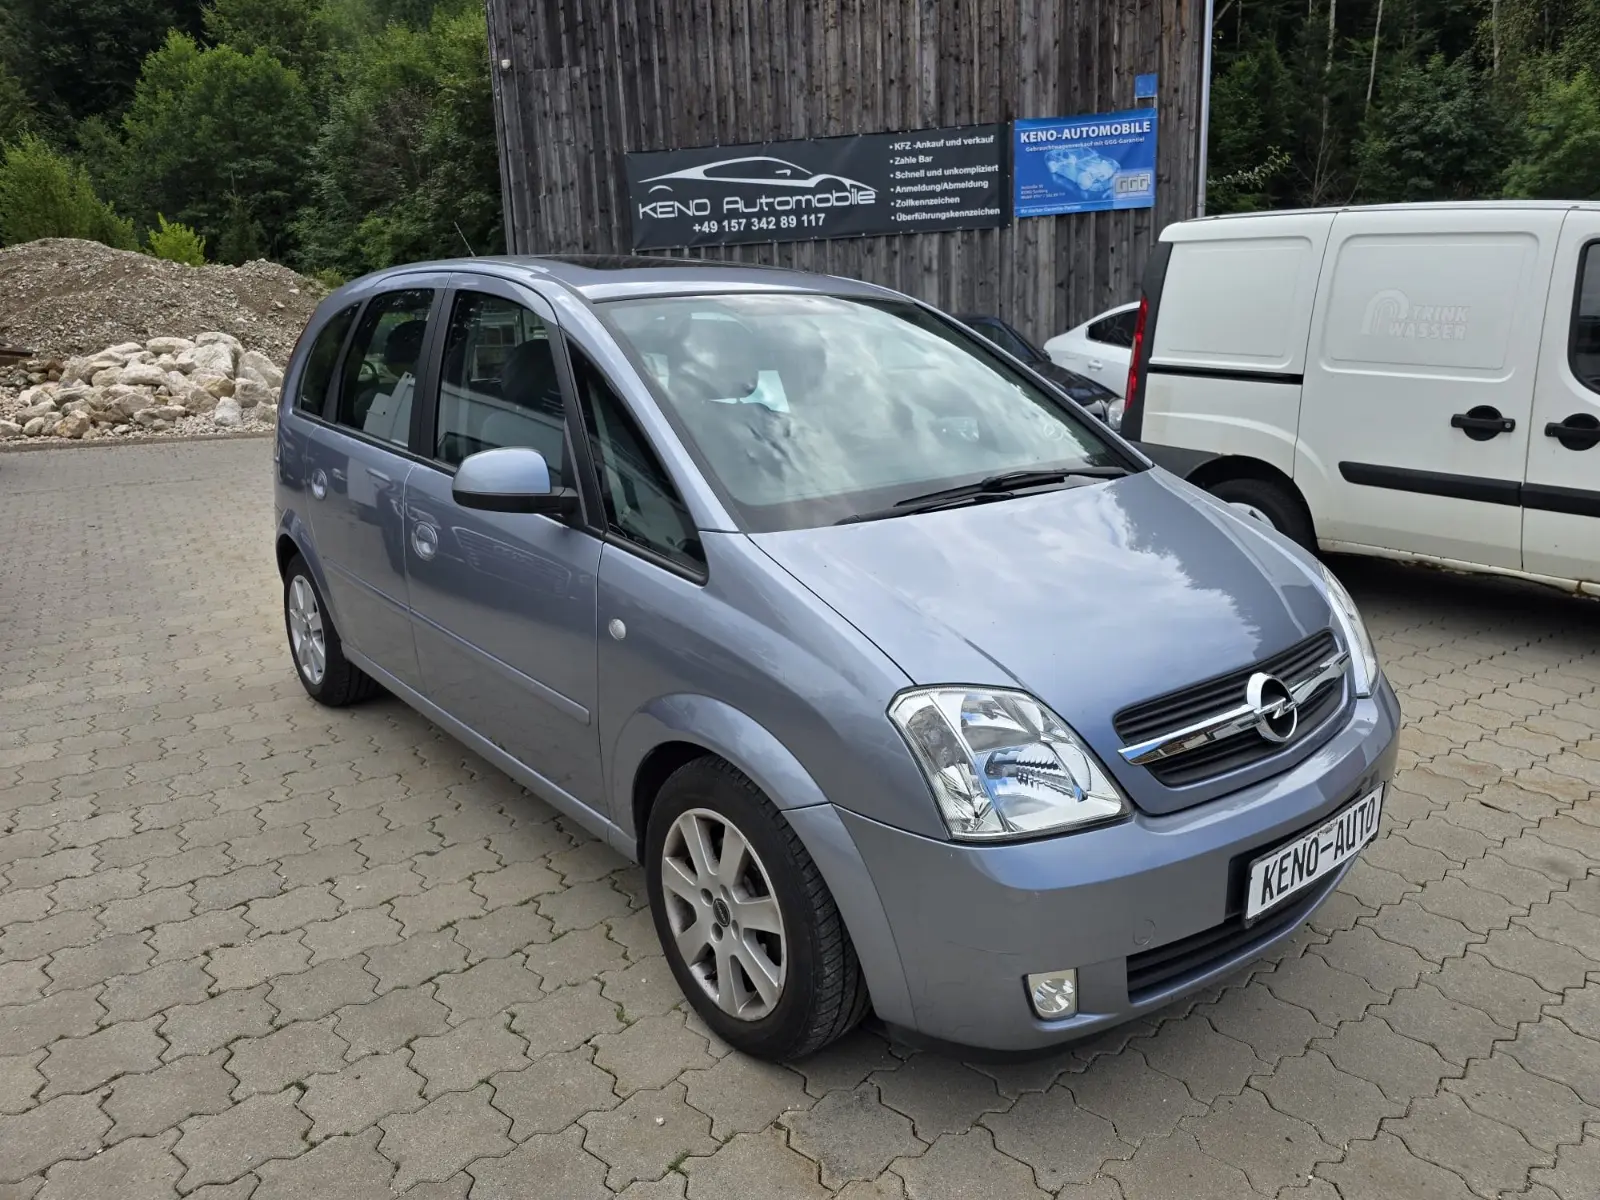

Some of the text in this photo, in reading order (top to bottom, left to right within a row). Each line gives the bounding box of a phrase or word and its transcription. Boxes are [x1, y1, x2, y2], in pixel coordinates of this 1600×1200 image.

[1020, 121, 1151, 143] KENO-AUTOMOBILE
[894, 141, 911, 151] KFZ
[945, 137, 961, 147] und
[963, 135, 994, 145] verkauf
[894, 155, 933, 165] Zahle Bar
[895, 164, 999, 179] Schnell und unkompliziert
[895, 180, 989, 193] Anmeldung/Abmeldung
[638, 188, 876, 219] KENO Automobile
[895, 196, 960, 208] Zollkennzeichen
[896, 207, 1000, 221] Überführungskennzeichen
[692, 213, 826, 233] +49 157 342 89 117
[1388, 321, 1467, 340] WASSER
[1261, 796, 1376, 906] KENO-AUTO
